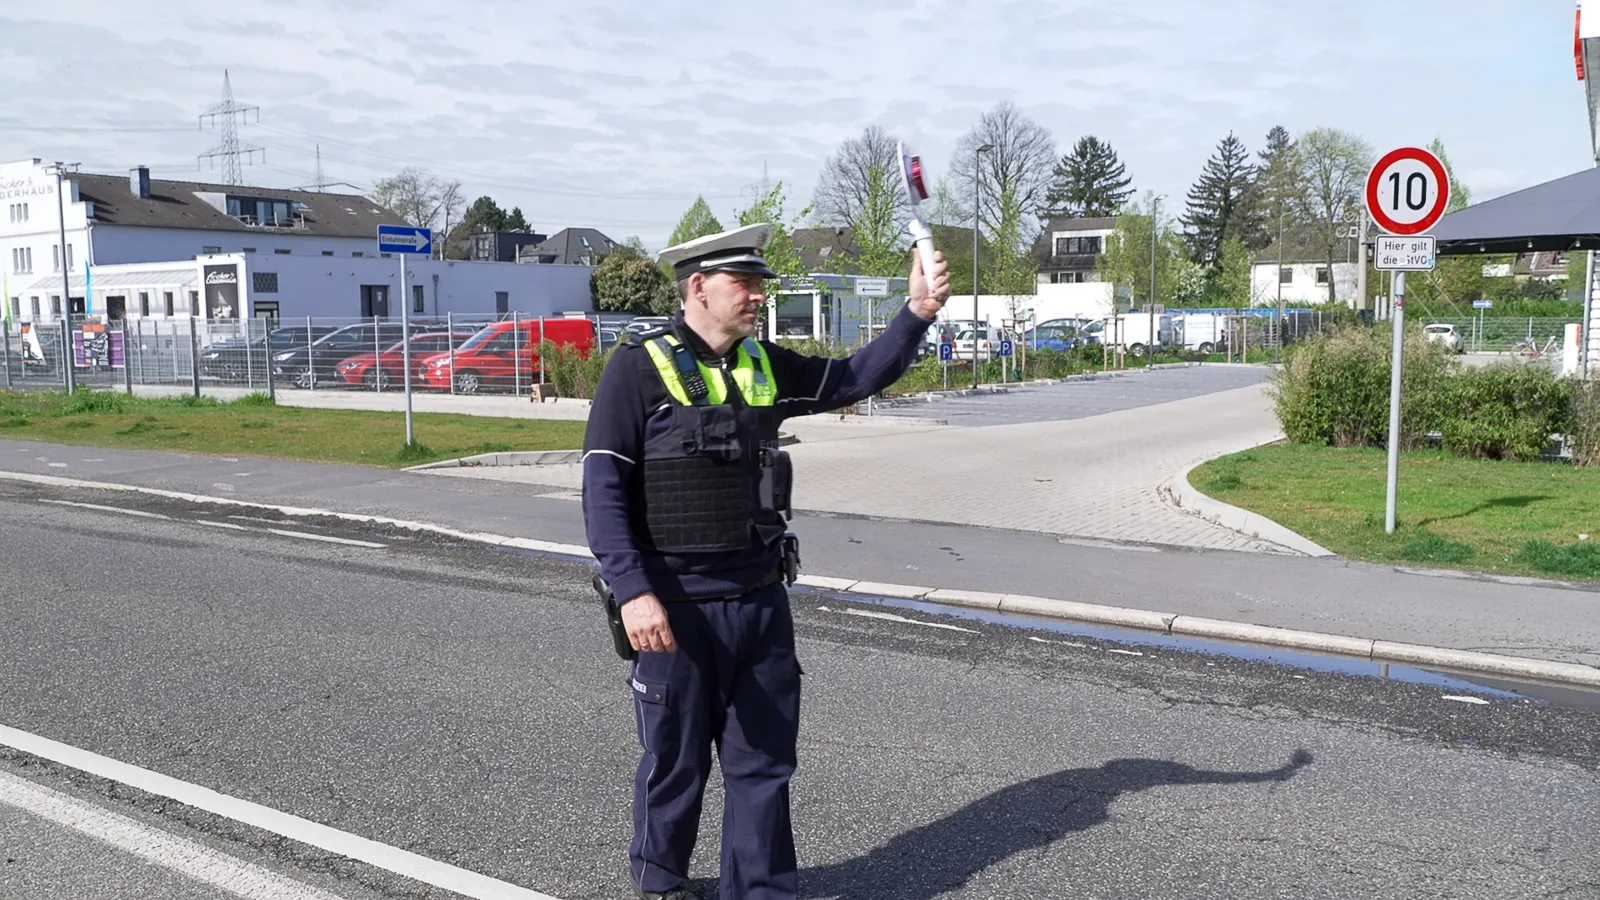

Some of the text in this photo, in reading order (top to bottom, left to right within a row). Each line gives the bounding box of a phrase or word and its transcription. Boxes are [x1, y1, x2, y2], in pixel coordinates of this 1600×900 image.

[1389, 172, 1427, 211] 10
[1384, 241, 1427, 253] Hier gilt
[1383, 255, 1398, 265] die
